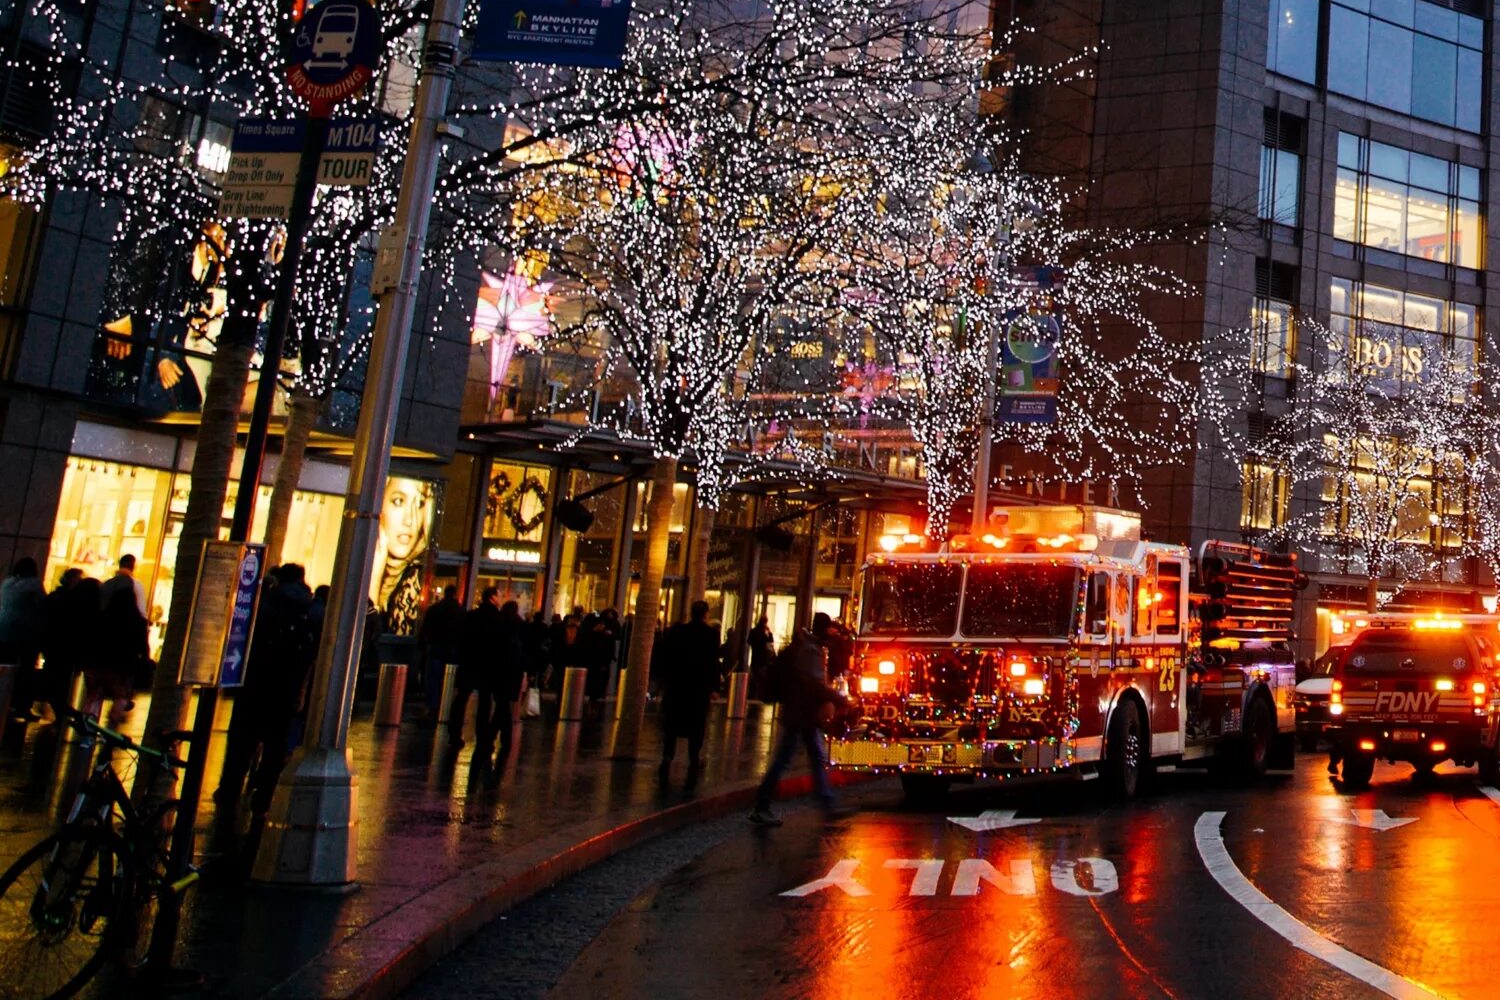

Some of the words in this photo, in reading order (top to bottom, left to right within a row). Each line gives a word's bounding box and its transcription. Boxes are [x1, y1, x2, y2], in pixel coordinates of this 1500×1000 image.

[532, 15, 599, 26] MANHATTAN
[530, 24, 598, 35] SKYLINE
[565, 38, 594, 46] RENTALS
[291, 70, 306, 88] NO
[304, 71, 362, 98] STANDING
[238, 124, 262, 135] Times
[265, 124, 296, 136] Square
[328, 123, 376, 147] M104
[231, 157, 248, 168] Pick
[323, 159, 369, 179] TOUR
[228, 170, 248, 182] Drop
[251, 170, 263, 181] Off
[265, 170, 284, 182] Only
[225, 190, 244, 201] Gray
[236, 203, 285, 216] Sightseeing
[238, 590, 252, 603] Bus
[234, 606, 249, 621] Stop
[1159, 657, 1175, 691] 23
[1375, 692, 1440, 713] FDNY
[778, 857, 1119, 896] ONLY
